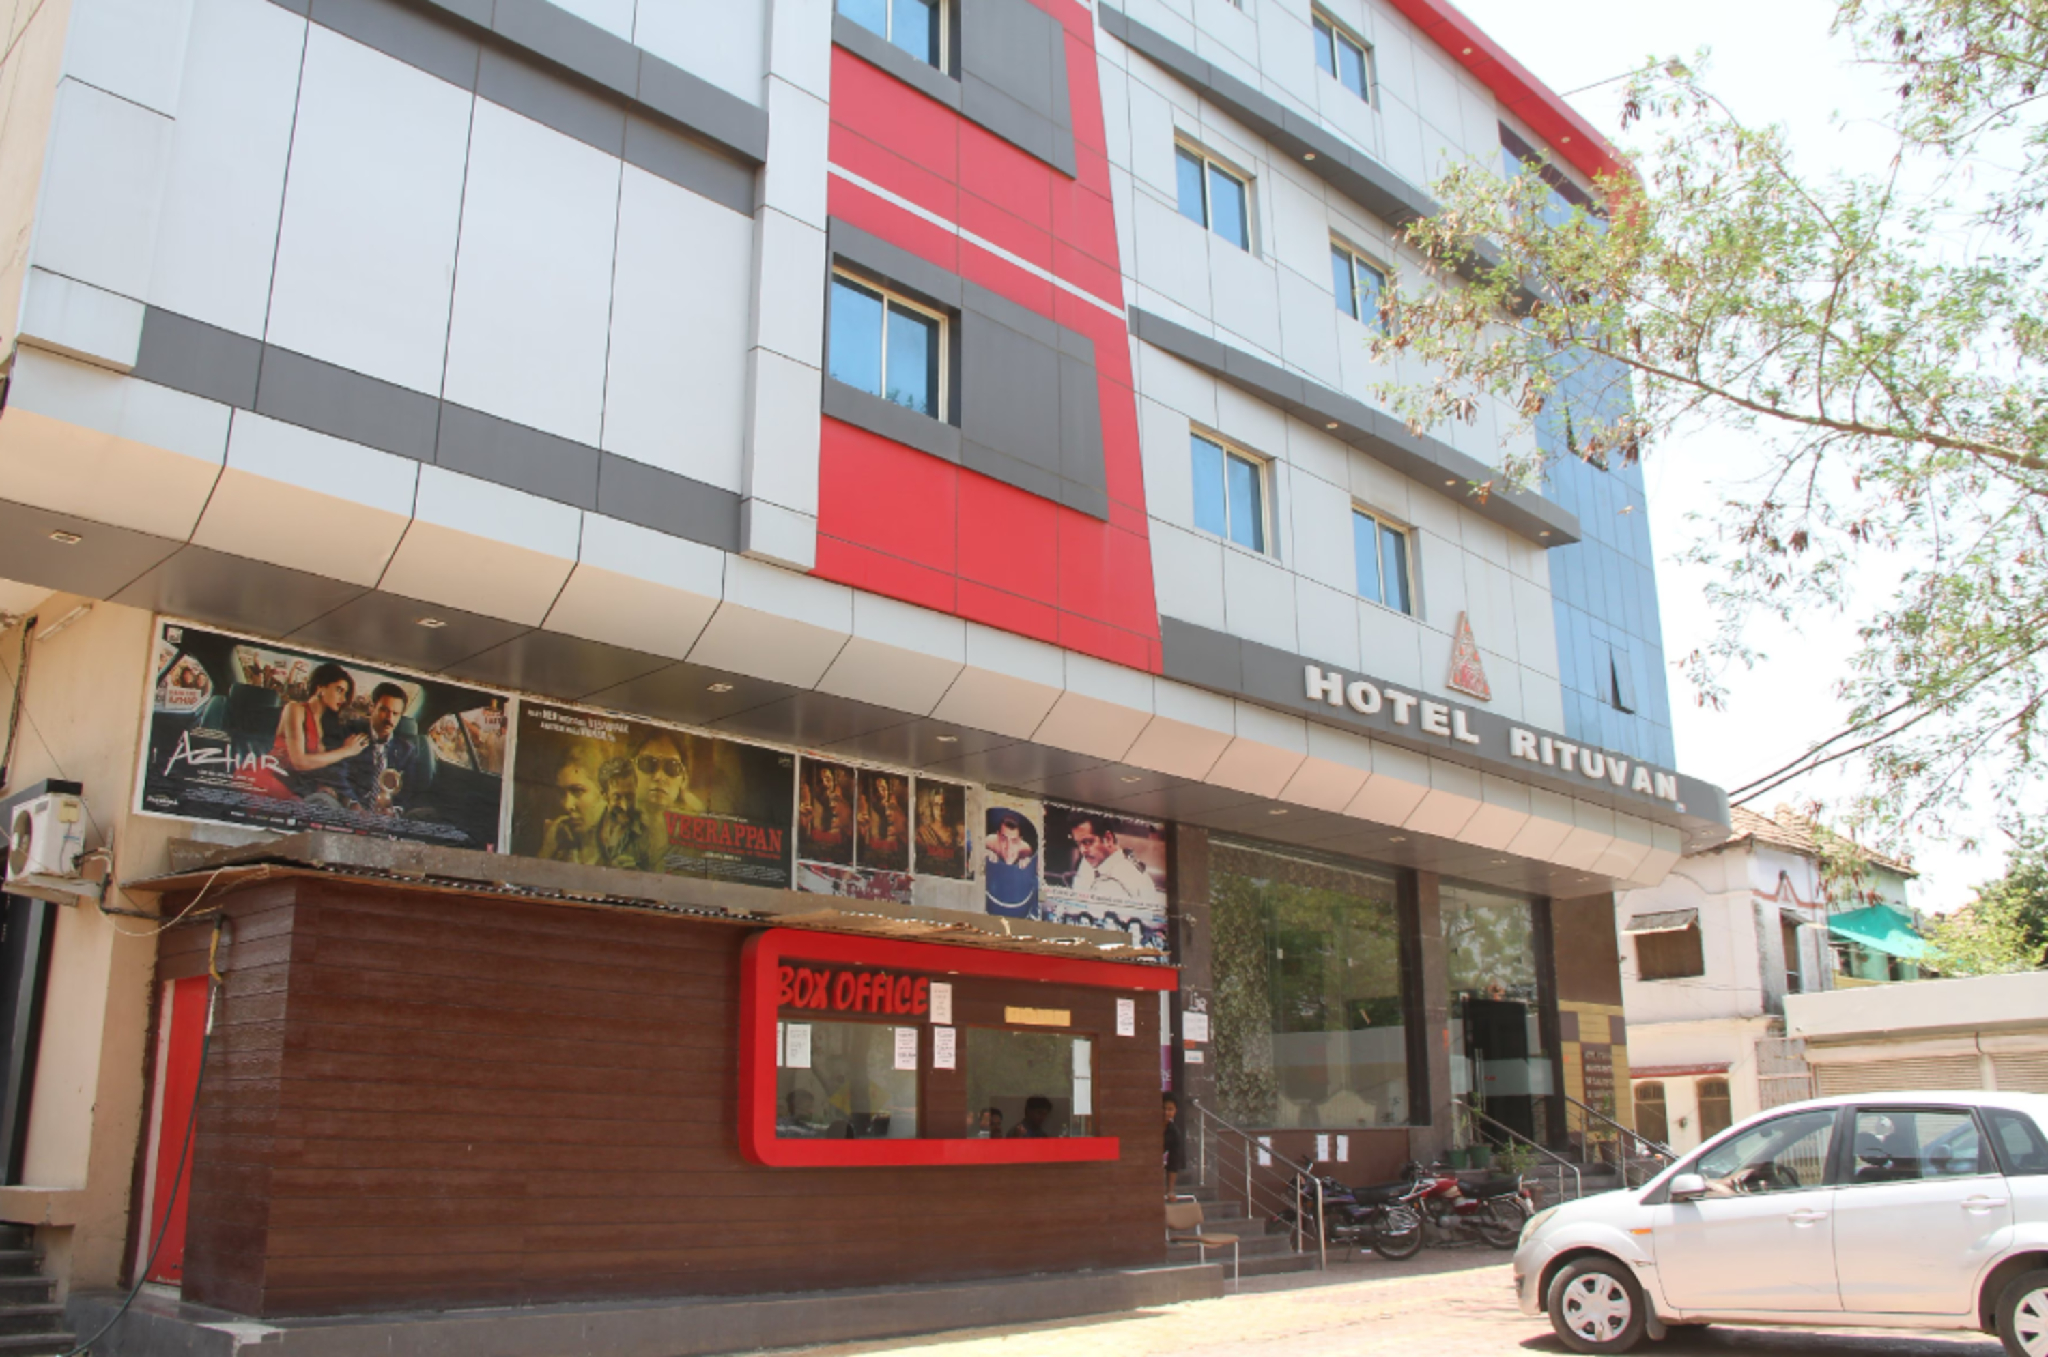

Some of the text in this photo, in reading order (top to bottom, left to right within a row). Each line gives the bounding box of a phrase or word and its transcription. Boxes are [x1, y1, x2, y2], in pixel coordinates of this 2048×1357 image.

[163, 730, 289, 776] AZHAR
[1304, 665, 1679, 801] HOTEL RITUVAN
[664, 811, 783, 853] VEERAPPAN
[778, 966, 831, 1009] BOX
[833, 971, 928, 1015] OFFICE
